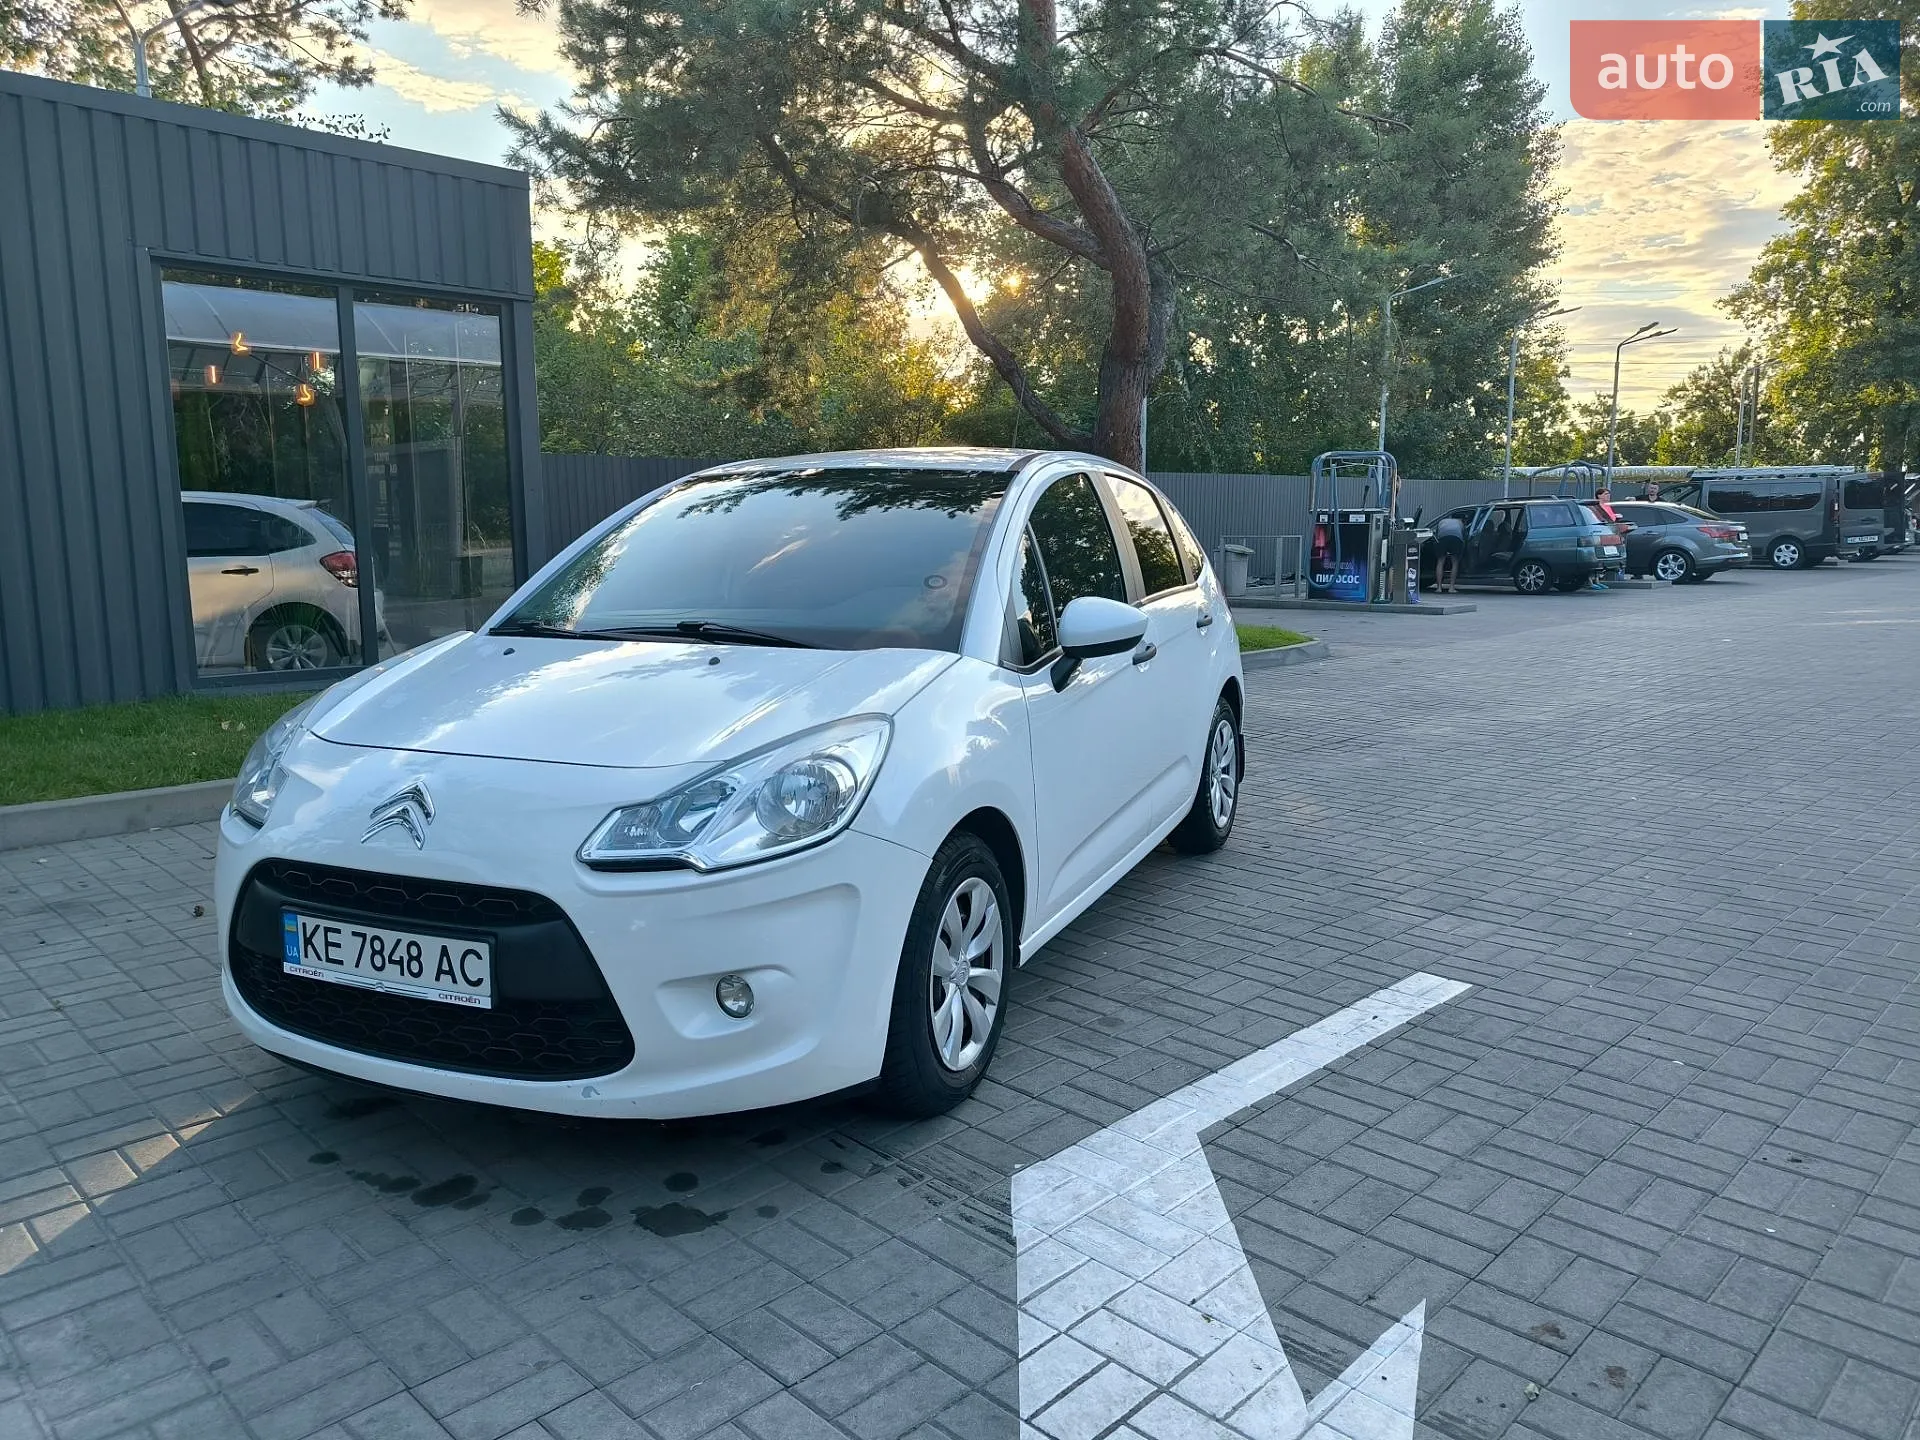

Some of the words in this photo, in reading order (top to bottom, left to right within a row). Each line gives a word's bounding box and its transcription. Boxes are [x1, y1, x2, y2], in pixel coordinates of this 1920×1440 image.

[286, 945, 299, 958] UA
[302, 921, 344, 966] KE
[351, 931, 424, 978] 7848
[435, 944, 484, 987] AC
